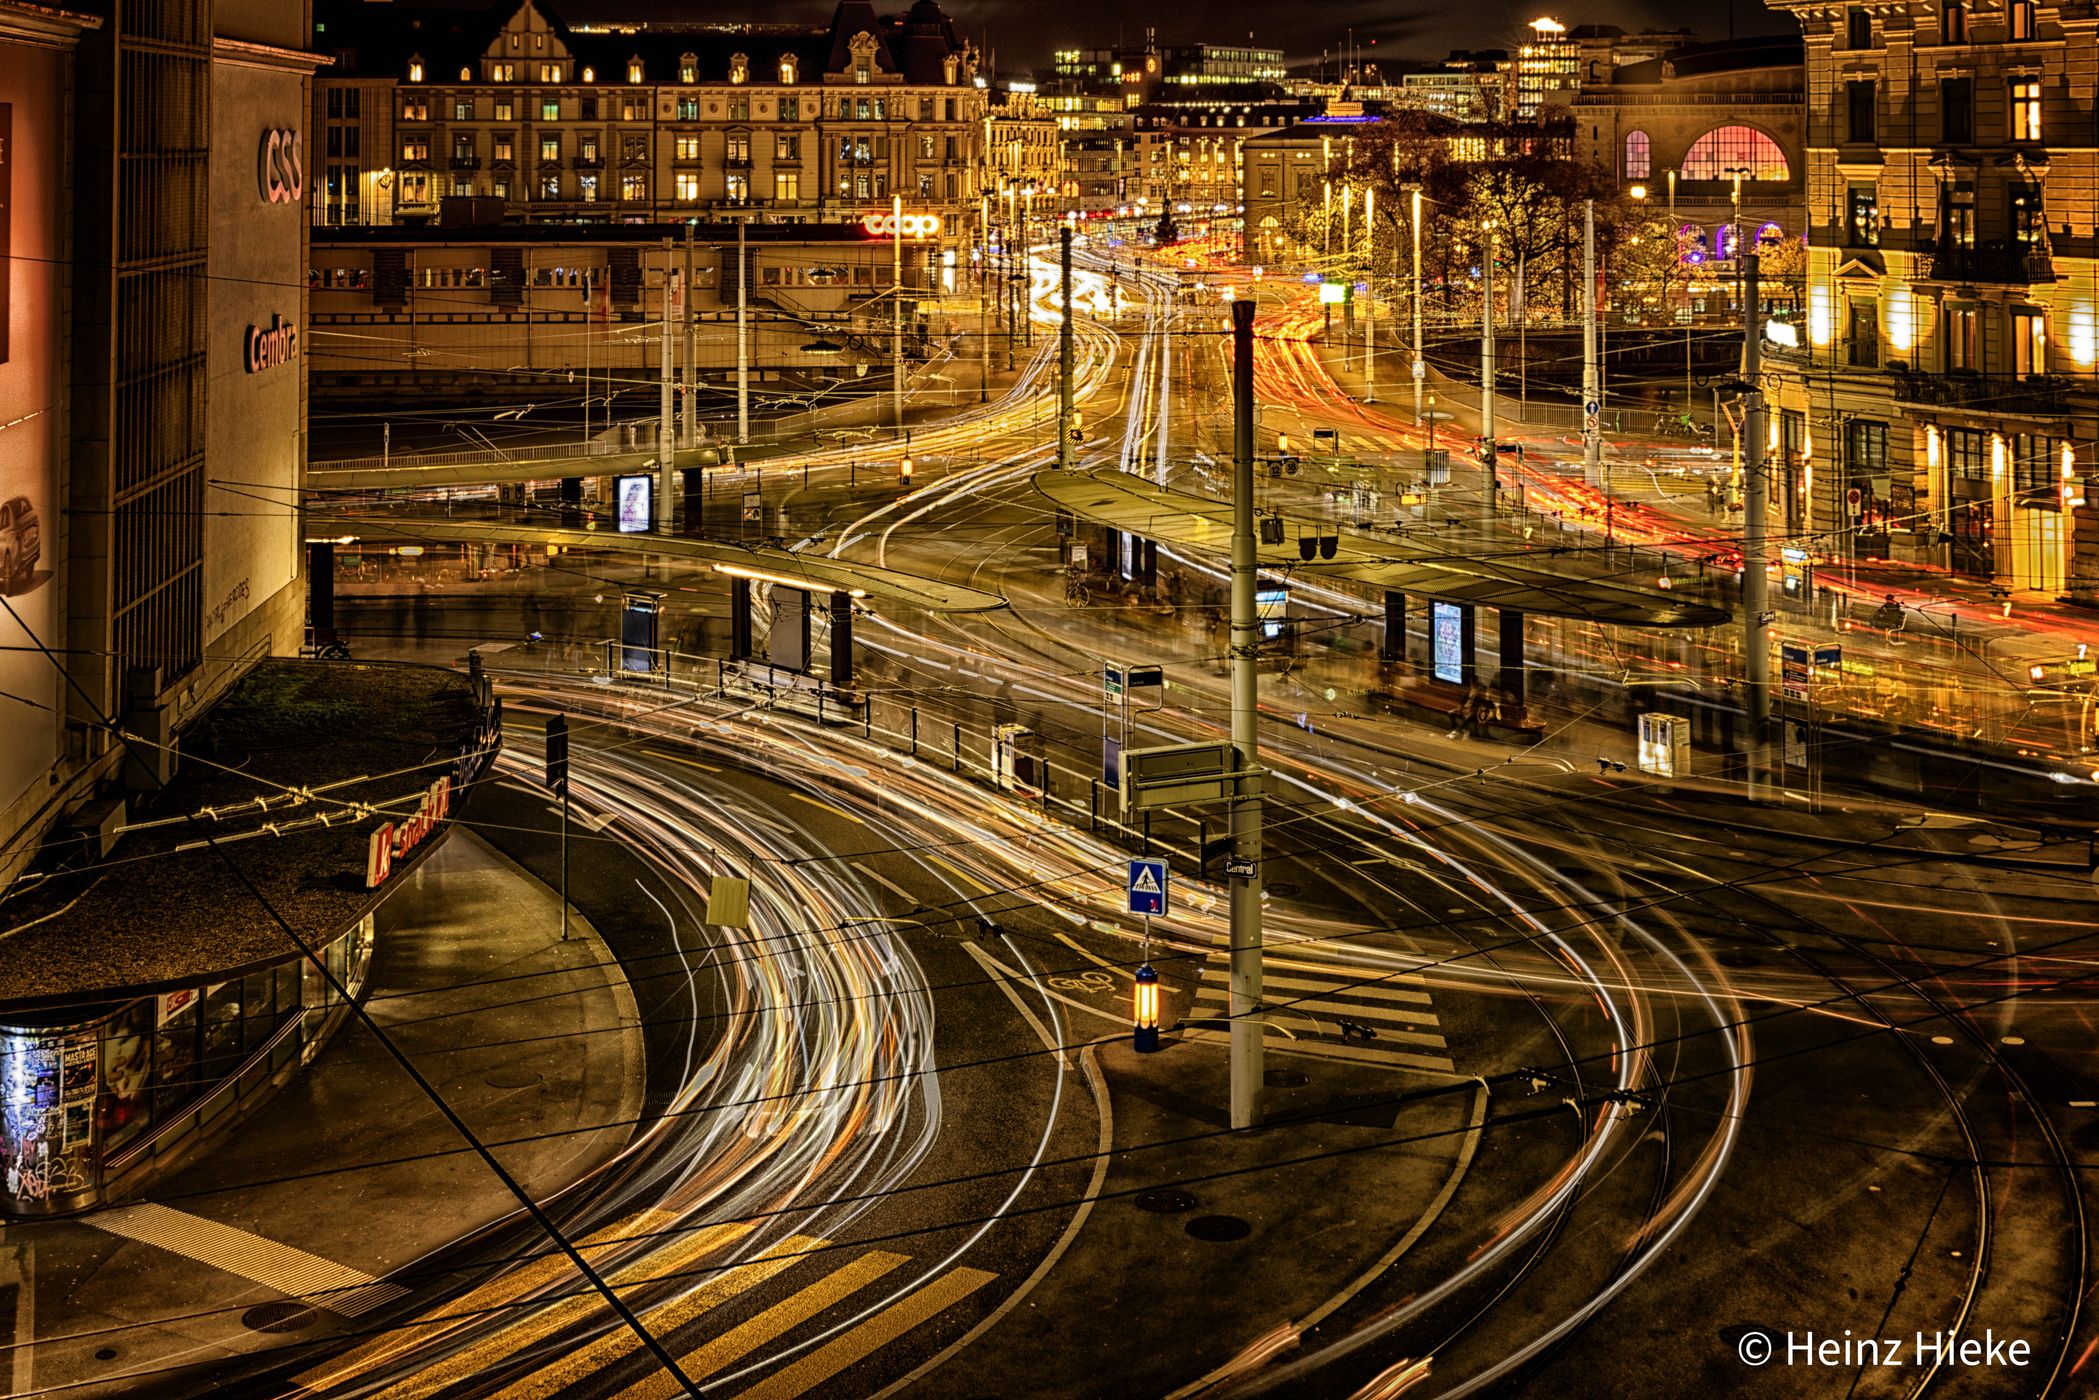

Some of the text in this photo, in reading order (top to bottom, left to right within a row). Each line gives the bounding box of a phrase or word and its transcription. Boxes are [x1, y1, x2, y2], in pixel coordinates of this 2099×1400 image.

[1121, 72, 1141, 83] POST
[864, 214, 940, 239] coop
[245, 313, 298, 374] Cembra
[1226, 861, 1253, 875] Central
[64, 1049, 86, 1063] MASTA
